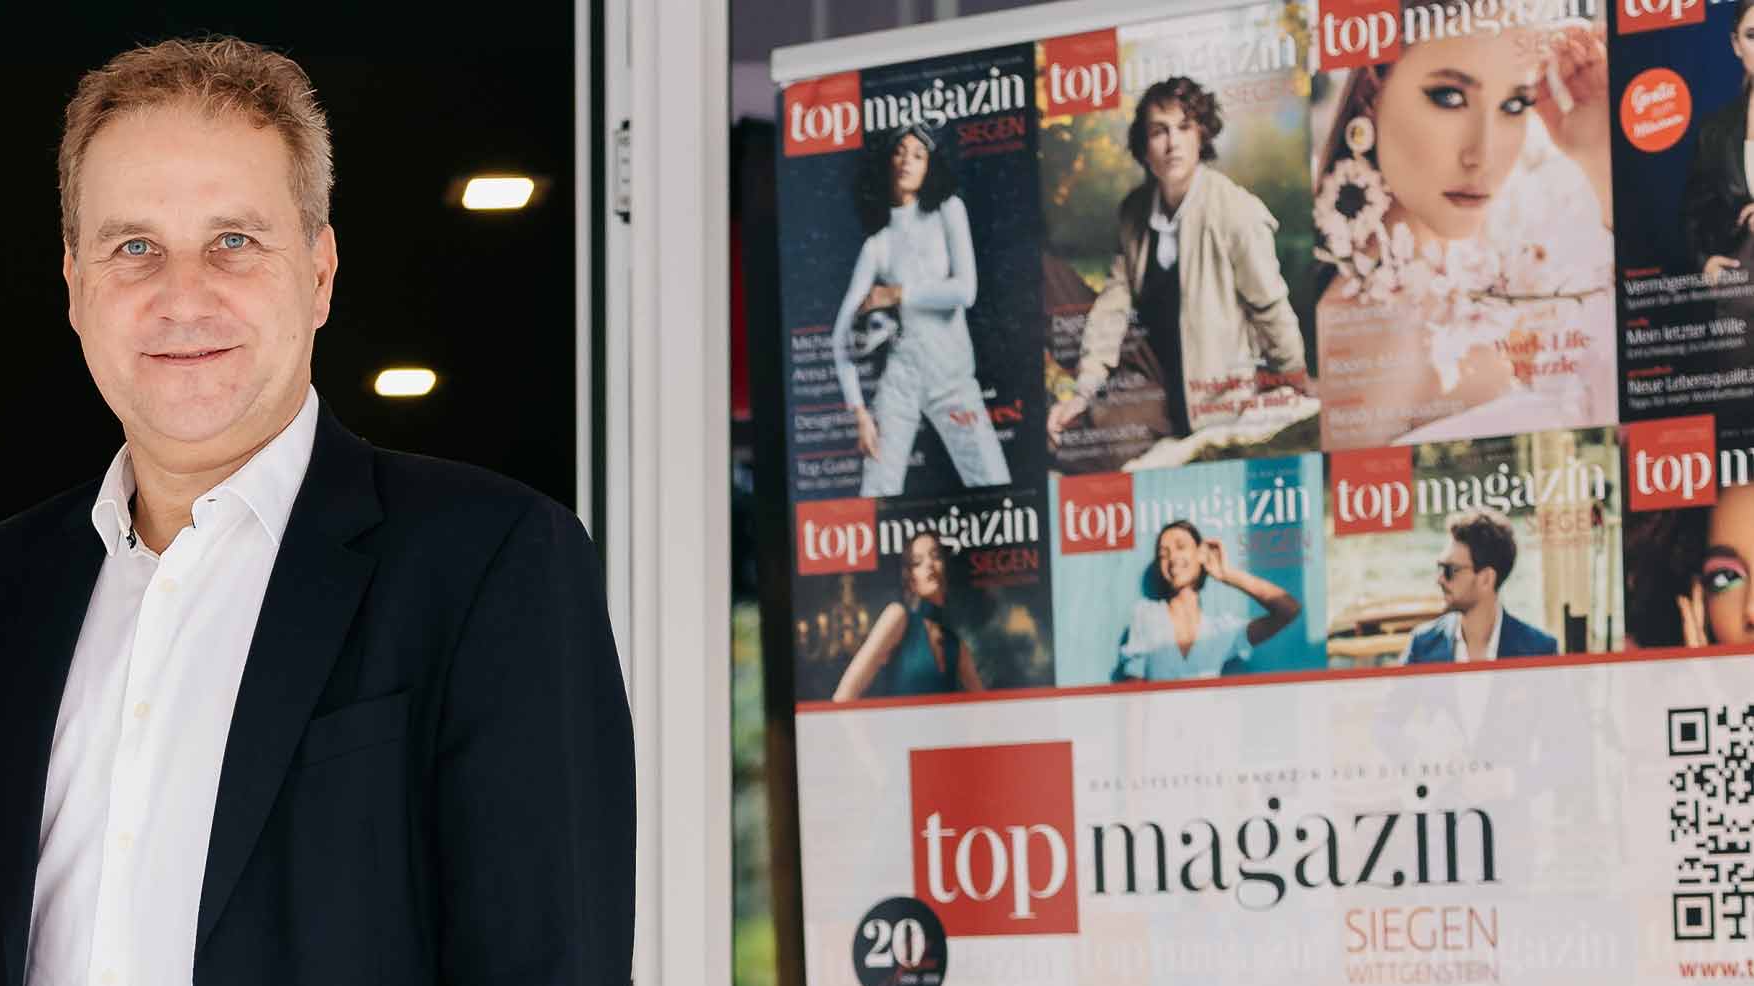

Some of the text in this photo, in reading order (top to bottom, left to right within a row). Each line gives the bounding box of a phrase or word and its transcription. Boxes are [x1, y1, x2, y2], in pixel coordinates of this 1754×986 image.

[1324, 11, 1397, 59] top
[790, 66, 1025, 145] top magazin
[1049, 62, 1118, 107] top
[1337, 456, 1605, 528] top magazin
[1634, 448, 1713, 500] top
[803, 519, 873, 567] top
[1064, 500, 1134, 547] top
[921, 784, 1502, 921] top magazin
[862, 917, 928, 969] 20
[1345, 905, 1499, 954] SIEGEN
[1345, 959, 1500, 985] WITTGENSTEIN
